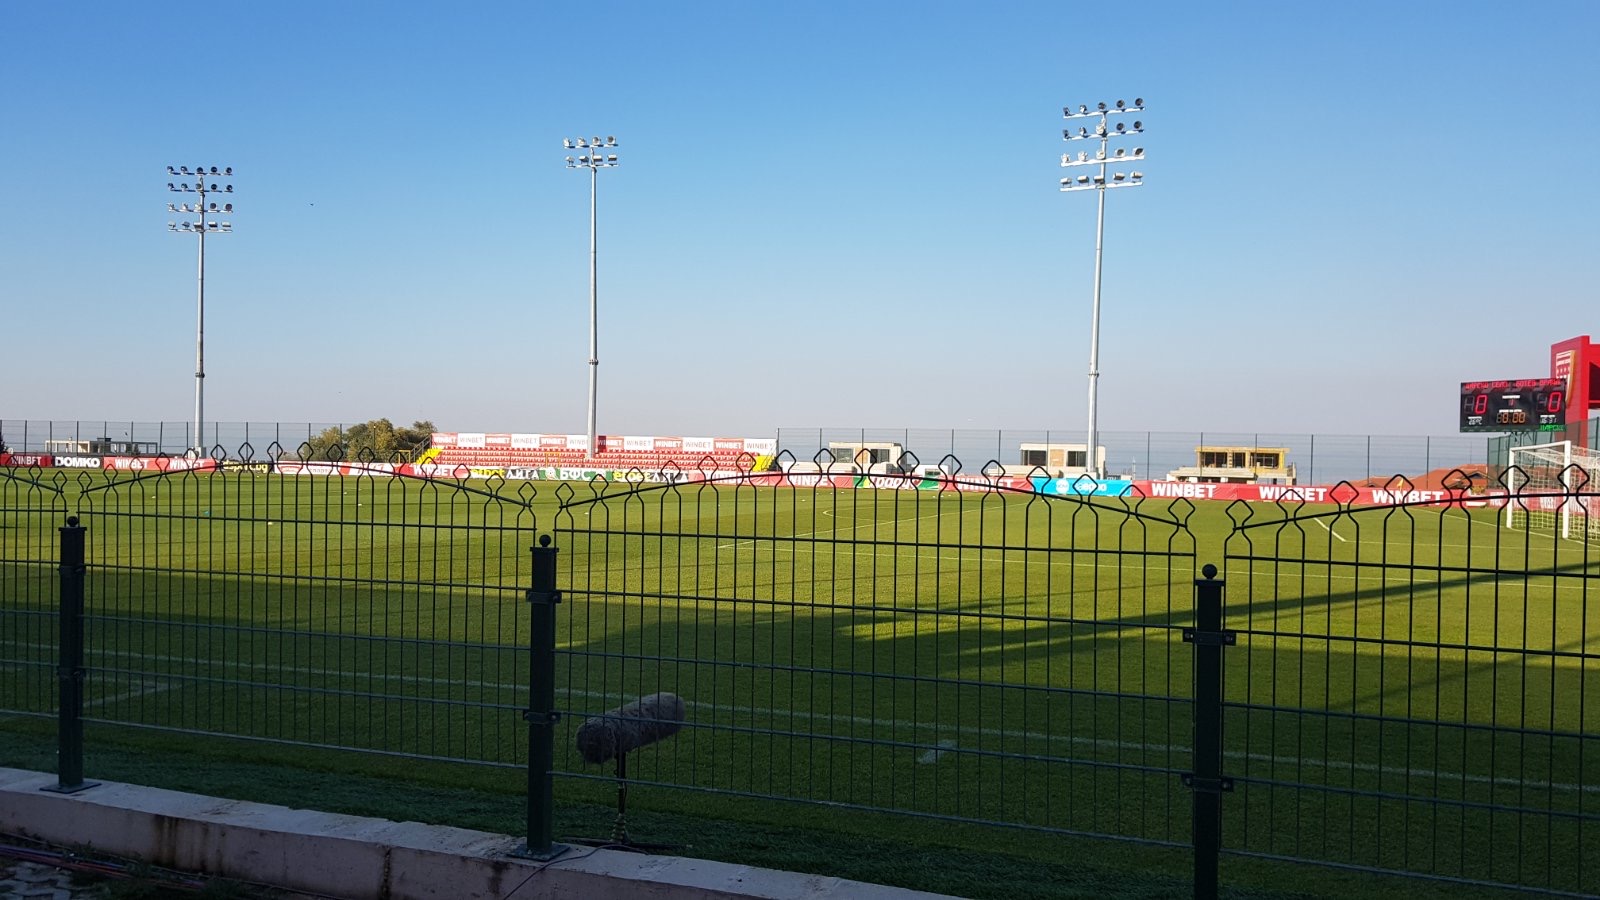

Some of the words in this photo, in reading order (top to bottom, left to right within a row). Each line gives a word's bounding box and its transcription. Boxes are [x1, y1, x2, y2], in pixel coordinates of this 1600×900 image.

[11, 455, 42, 466] WINBET
[55, 456, 100, 469] DOMKO
[114, 458, 149, 470] WINBET
[413, 464, 455, 477] WINBET
[560, 468, 591, 481] БФС
[1151, 482, 1217, 498] WINBET
[1259, 485, 1328, 502] WINBET
[1372, 489, 1444, 506] WINBET
